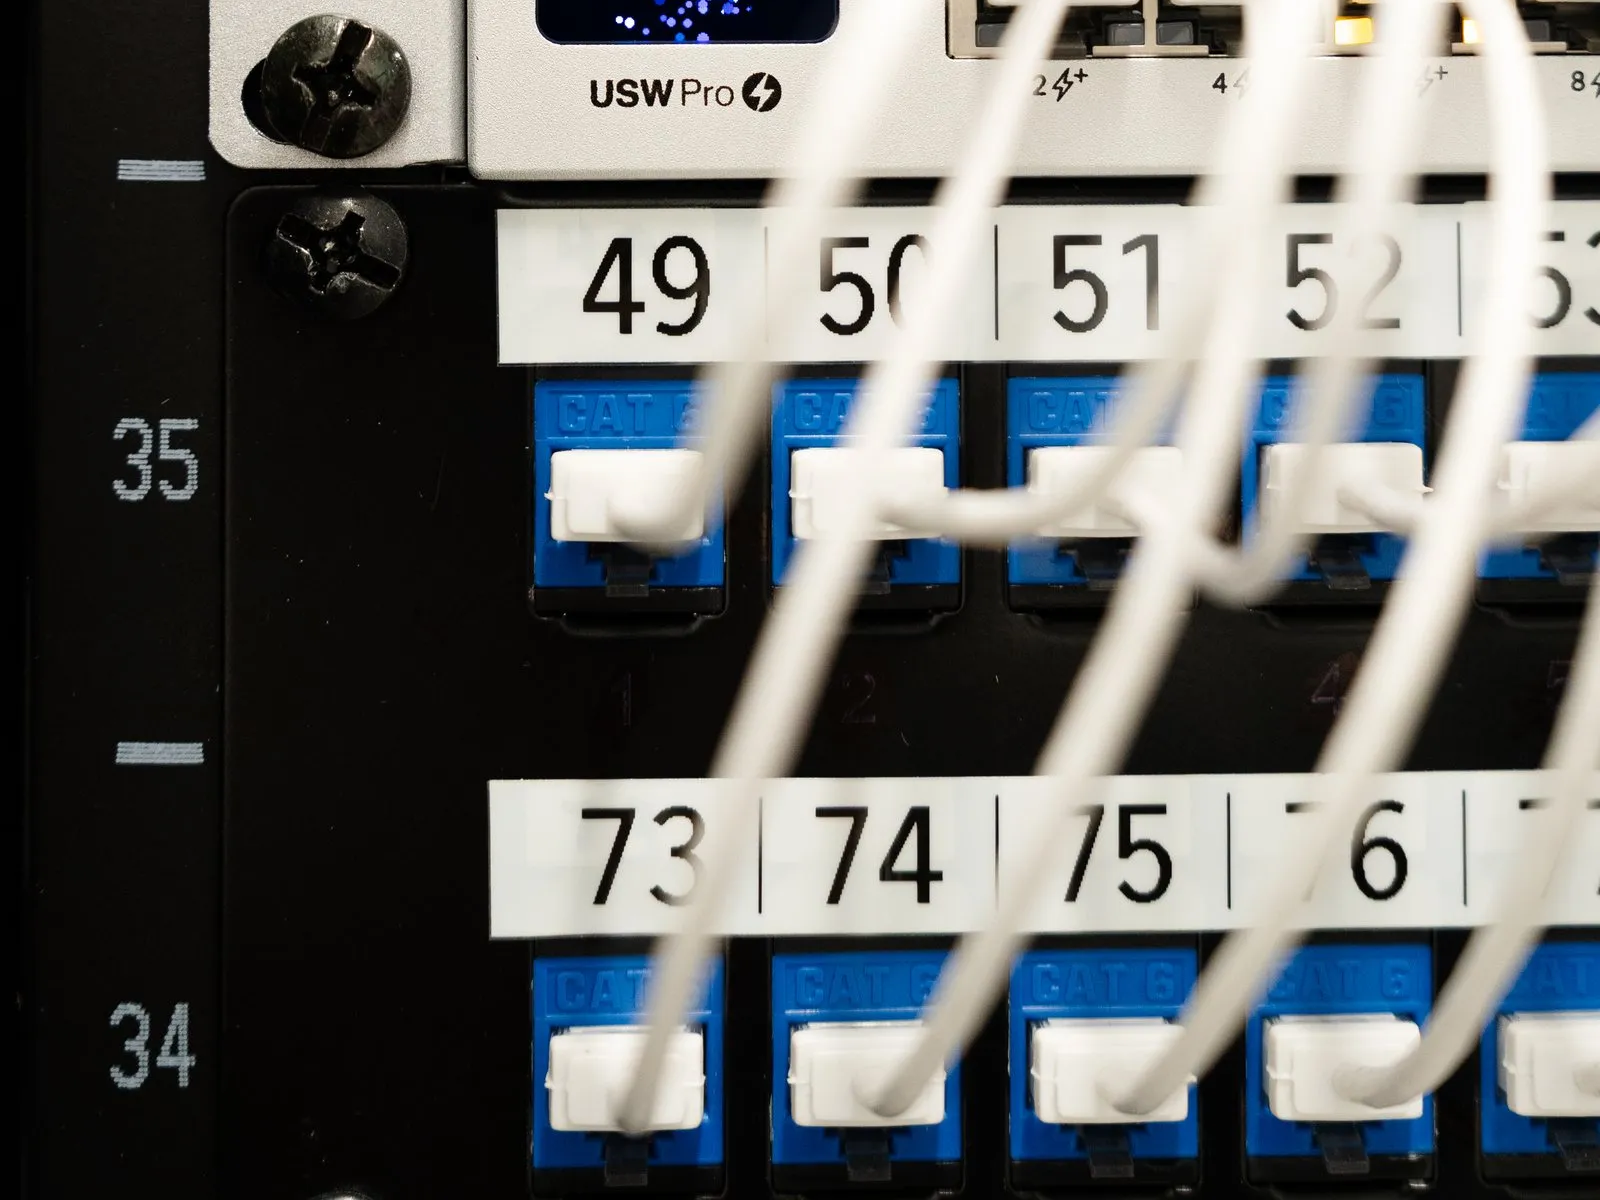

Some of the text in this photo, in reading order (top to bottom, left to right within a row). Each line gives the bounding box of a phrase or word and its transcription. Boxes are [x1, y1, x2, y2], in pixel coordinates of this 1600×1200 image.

[590, 79, 734, 108] USW Pro
[583, 235, 710, 336] 49
[1053, 234, 1160, 333] 51
[1286, 233, 1402, 331] 52
[112, 418, 199, 500] 35
[558, 394, 653, 433] CAT
[581, 805, 705, 906] 73
[815, 806, 943, 905] 74
[1064, 803, 1173, 903] 75
[797, 966, 889, 1008] CAT
[1032, 961, 1176, 1003] CAT 6
[110, 1002, 196, 1088] 34
